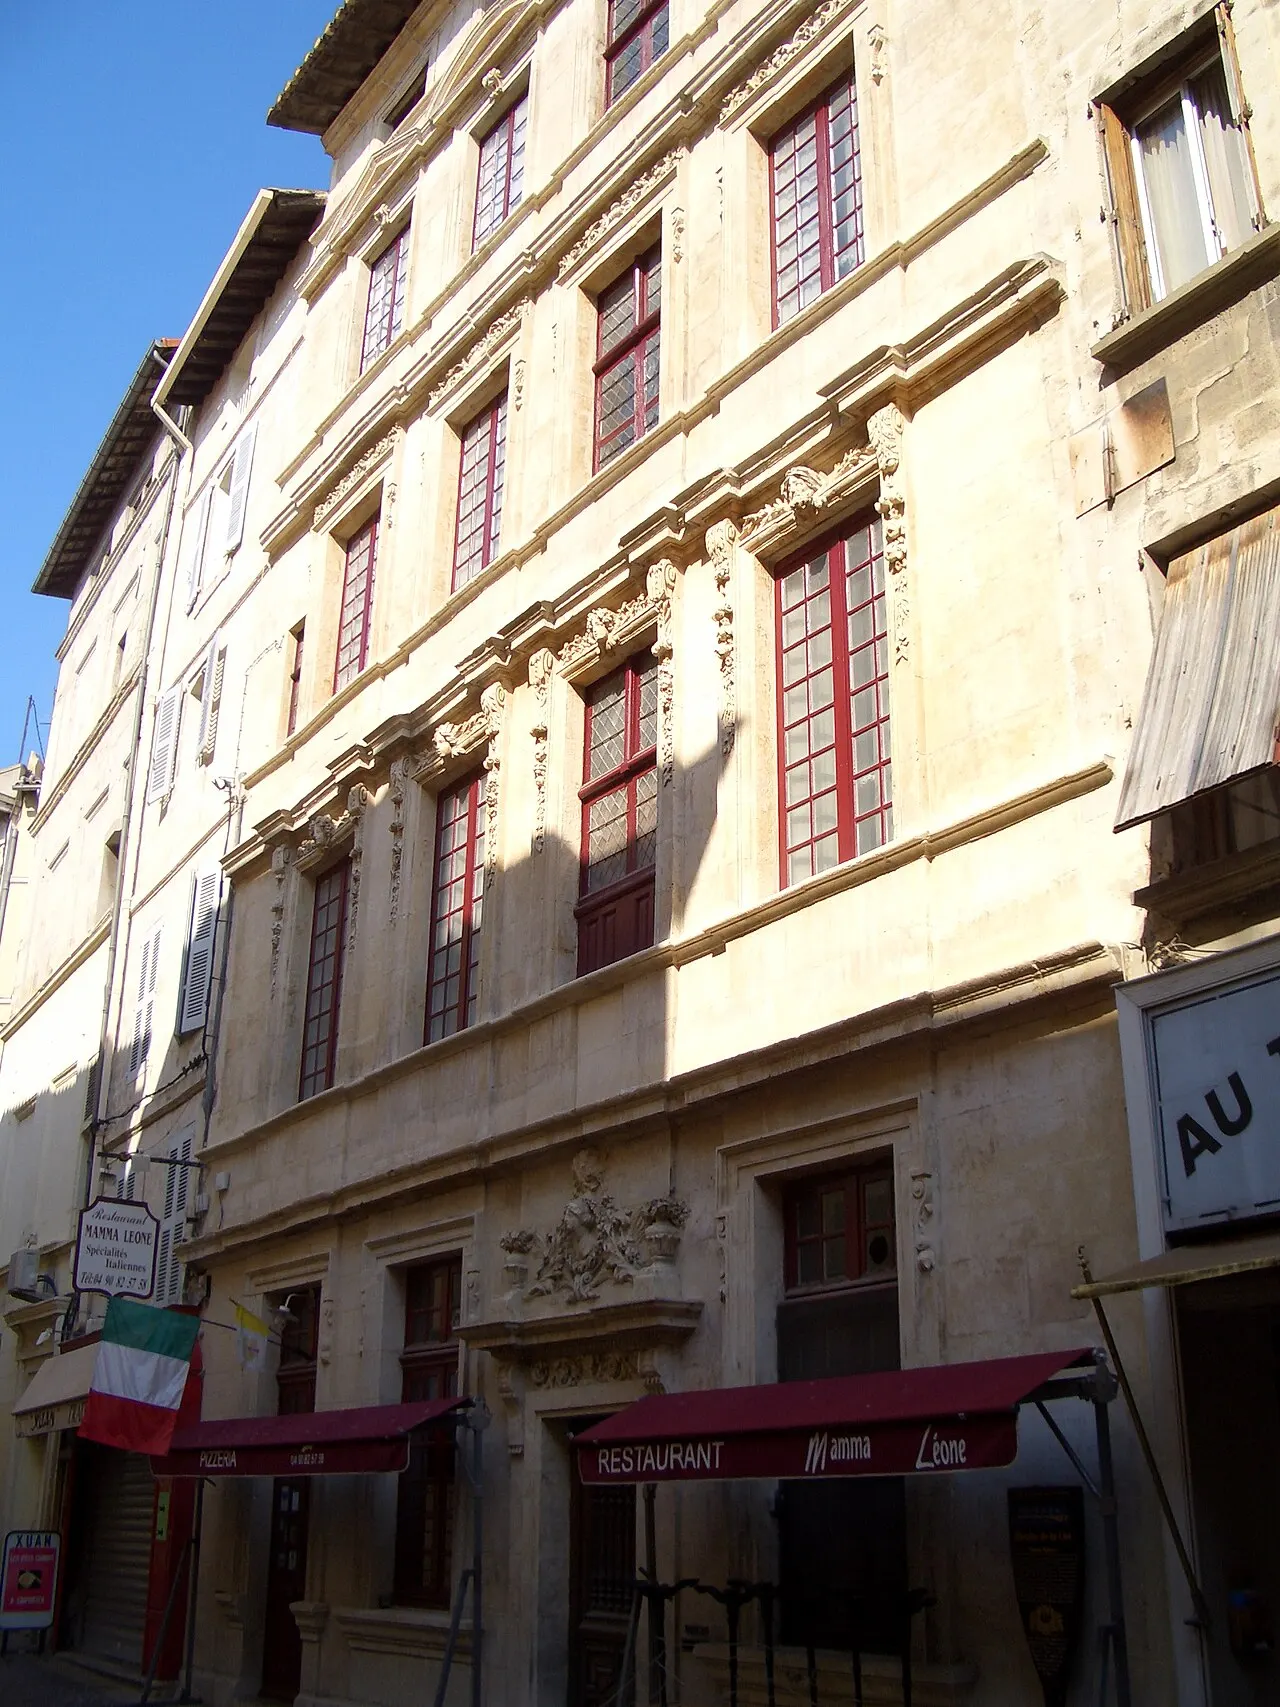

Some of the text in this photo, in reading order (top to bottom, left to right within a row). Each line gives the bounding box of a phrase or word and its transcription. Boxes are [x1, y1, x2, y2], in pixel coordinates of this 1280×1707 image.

[1176, 1072, 1253, 1178] AU
[92, 1208, 148, 1225] Restaurant
[86, 1225, 152, 1245] MAMMA LEONE
[105, 1259, 146, 1273] Italiennes
[598, 1425, 966, 1474] RESTAURANT Mamma Léone
[199, 1450, 237, 1468] PIZZERIA
[16, 1535, 52, 1548] XUAN
